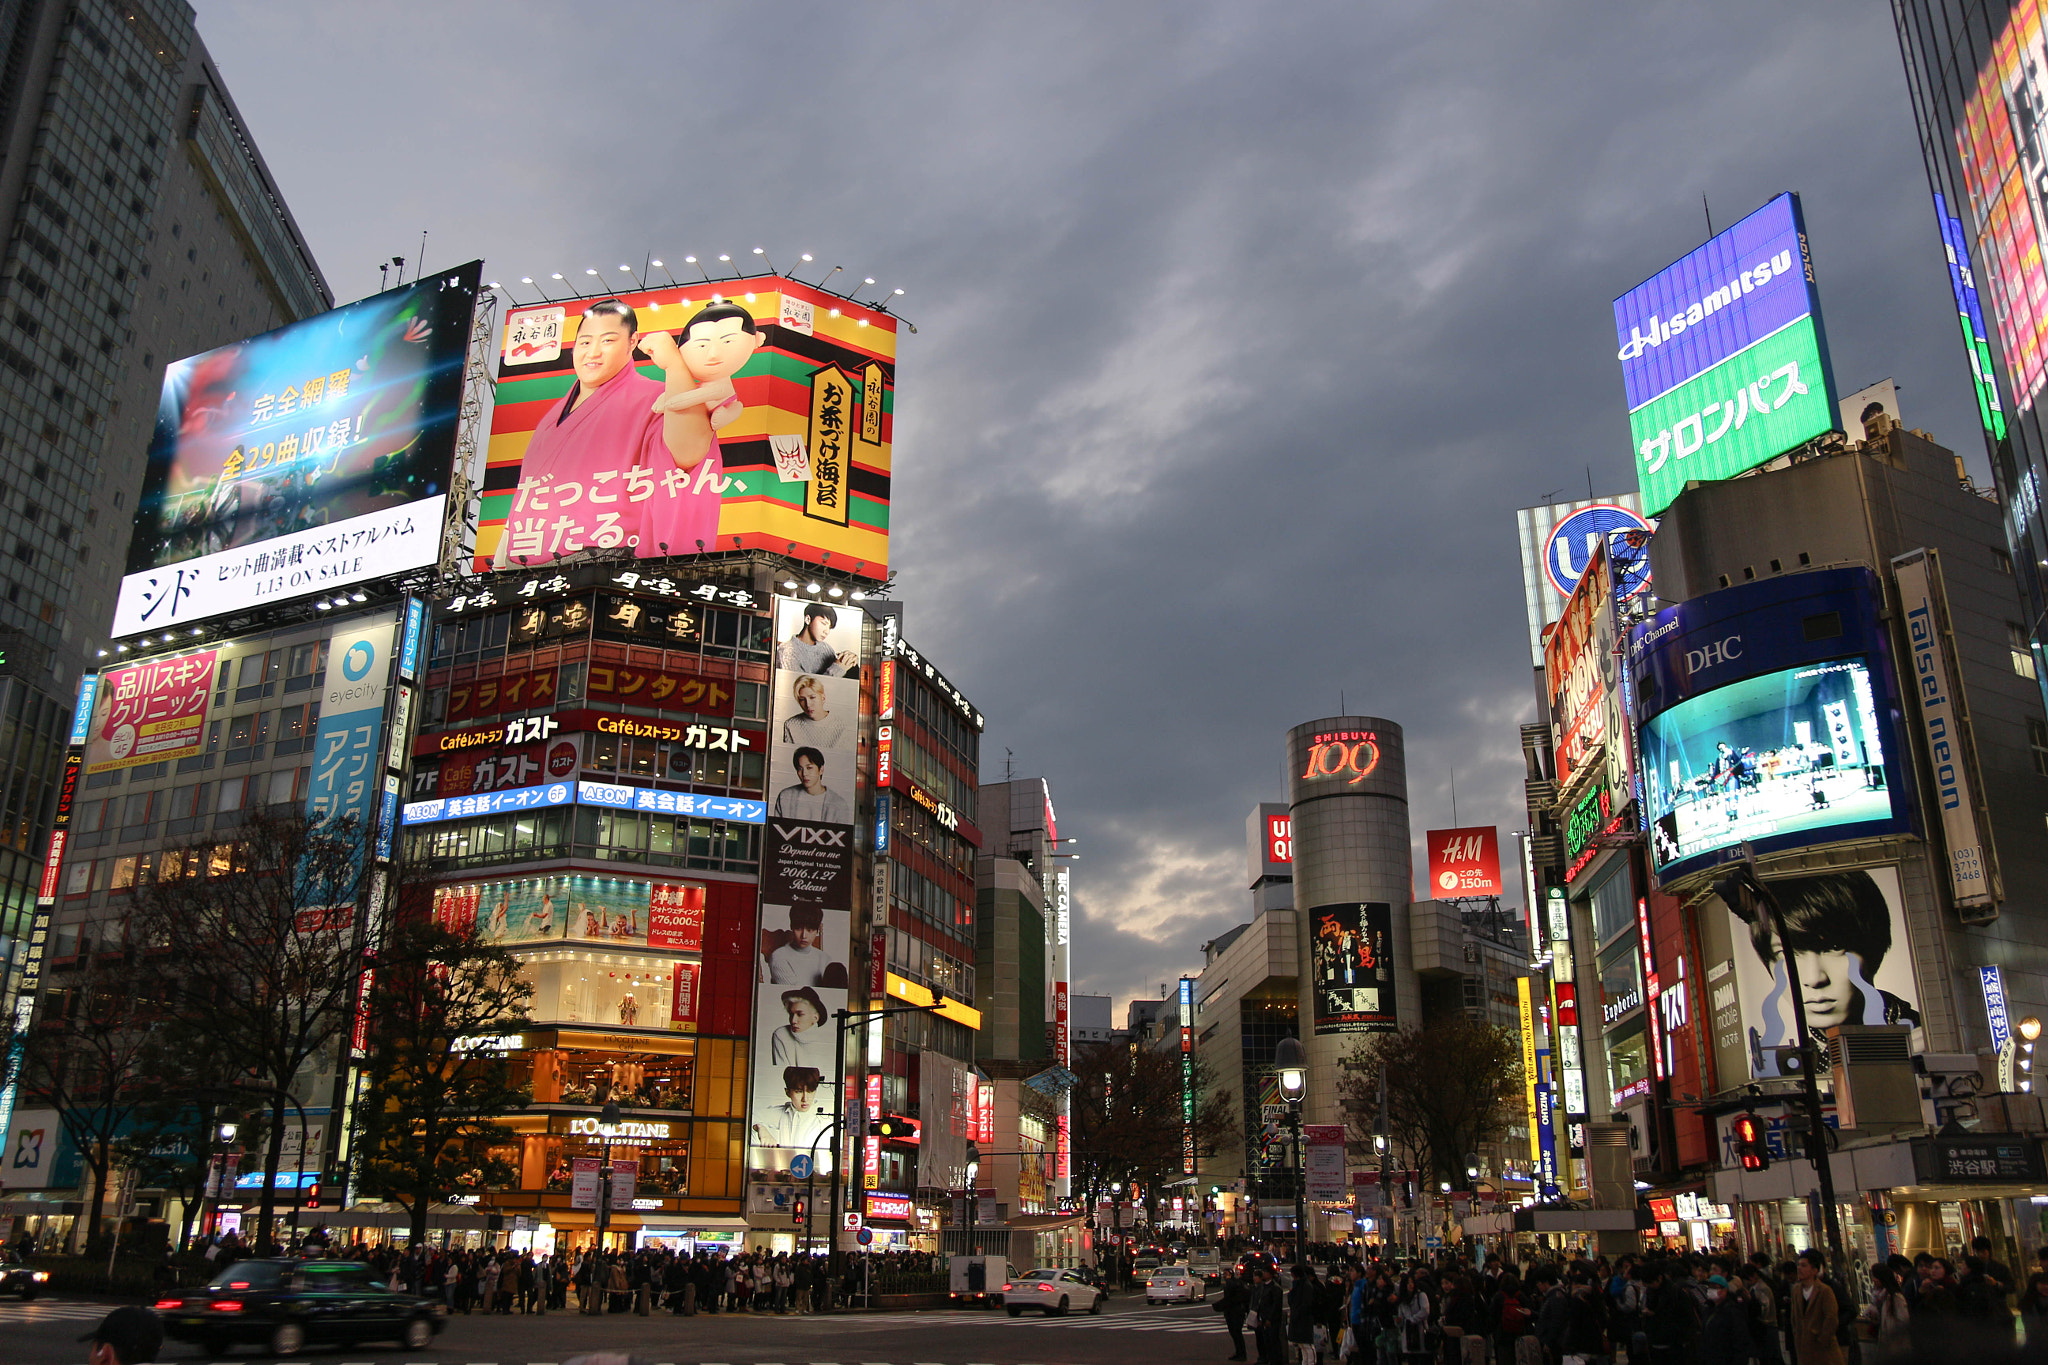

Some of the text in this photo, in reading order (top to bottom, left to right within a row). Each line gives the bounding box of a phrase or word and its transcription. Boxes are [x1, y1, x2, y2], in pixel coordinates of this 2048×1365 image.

[1797, 232, 1816, 284] サロンパス
[783, 307, 811, 322] 永谷園
[1618, 249, 1791, 361] Hisamitsu
[513, 324, 558, 343] 永谷園
[250, 368, 351, 425] 完全網羅
[865, 378, 881, 436] 永谷園の
[1640, 360, 1809, 475] サロンパス
[816, 381, 846, 509] お茶づけ海苔
[514, 458, 749, 513] だっこちゃん、
[509, 511, 640, 557] 当たる。
[217, 516, 416, 582] ヒット曲満載ベストアルバム
[253, 557, 363, 597] 1.13 ON SALE
[140, 568, 200, 621] シド
[609, 600, 696, 638] 月の宴
[1630, 617, 1679, 657] DHC Channel
[1686, 635, 1743, 674] DHC
[115, 659, 212, 701] 品川スキン
[330, 683, 378, 705] eyecity
[451, 670, 554, 713] プライス
[589, 667, 730, 708] コンタクト
[112, 686, 206, 728] クリニック
[1908, 597, 1960, 810] Taisei neon
[506, 715, 559, 744] ガスト
[684, 724, 750, 752] ガスト
[1315, 732, 1377, 743] SHIBUYA
[115, 745, 127, 754] 4F
[1302, 740, 1380, 784] 109
[415, 769, 439, 792] 7F
[473, 753, 540, 792] ガスト
[879, 752, 890, 781] ガスト
[448, 790, 543, 817] 英会話イーオン
[550, 786, 565, 799] 6F
[583, 787, 627, 803] AEON
[638, 790, 762, 820] 英会話イーオン
[408, 804, 443, 820] AEON
[938, 803, 959, 831] ガスト
[773, 823, 846, 847] VIXX
[1442, 835, 1483, 864] H&M
[779, 844, 841, 859] Depend on me
[794, 859, 814, 867] Original
[1730, 848, 1745, 858] DH
[1953, 848, 1974, 860] (03)
[1954, 860, 1978, 872] 3719
[780, 867, 837, 880] 2016.1.27
[789, 878, 828, 892] Release
[1460, 868, 1483, 877] この先
[1460, 878, 1492, 888] 150m
[1955, 870, 1981, 882] 2468
[876, 868, 884, 921] 渋谷駅前ビル
[1057, 873, 1067, 945] BIC CAMERA
[678, 969, 693, 1016] 毎日開催
[1604, 988, 1638, 1022] Euphoria
[1661, 981, 1687, 1031] クスリ
[1713, 982, 1736, 1011] DMM
[1716, 1008, 1738, 1030] mobile
[1721, 1030, 1740, 1049] のスマホ
[980, 1109, 988, 1131] アコム
[1263, 1105, 1287, 1114] FINAL
[1540, 1091, 1549, 1125] MIZUHO
[1949, 1160, 1998, 1175] 渋谷駅
